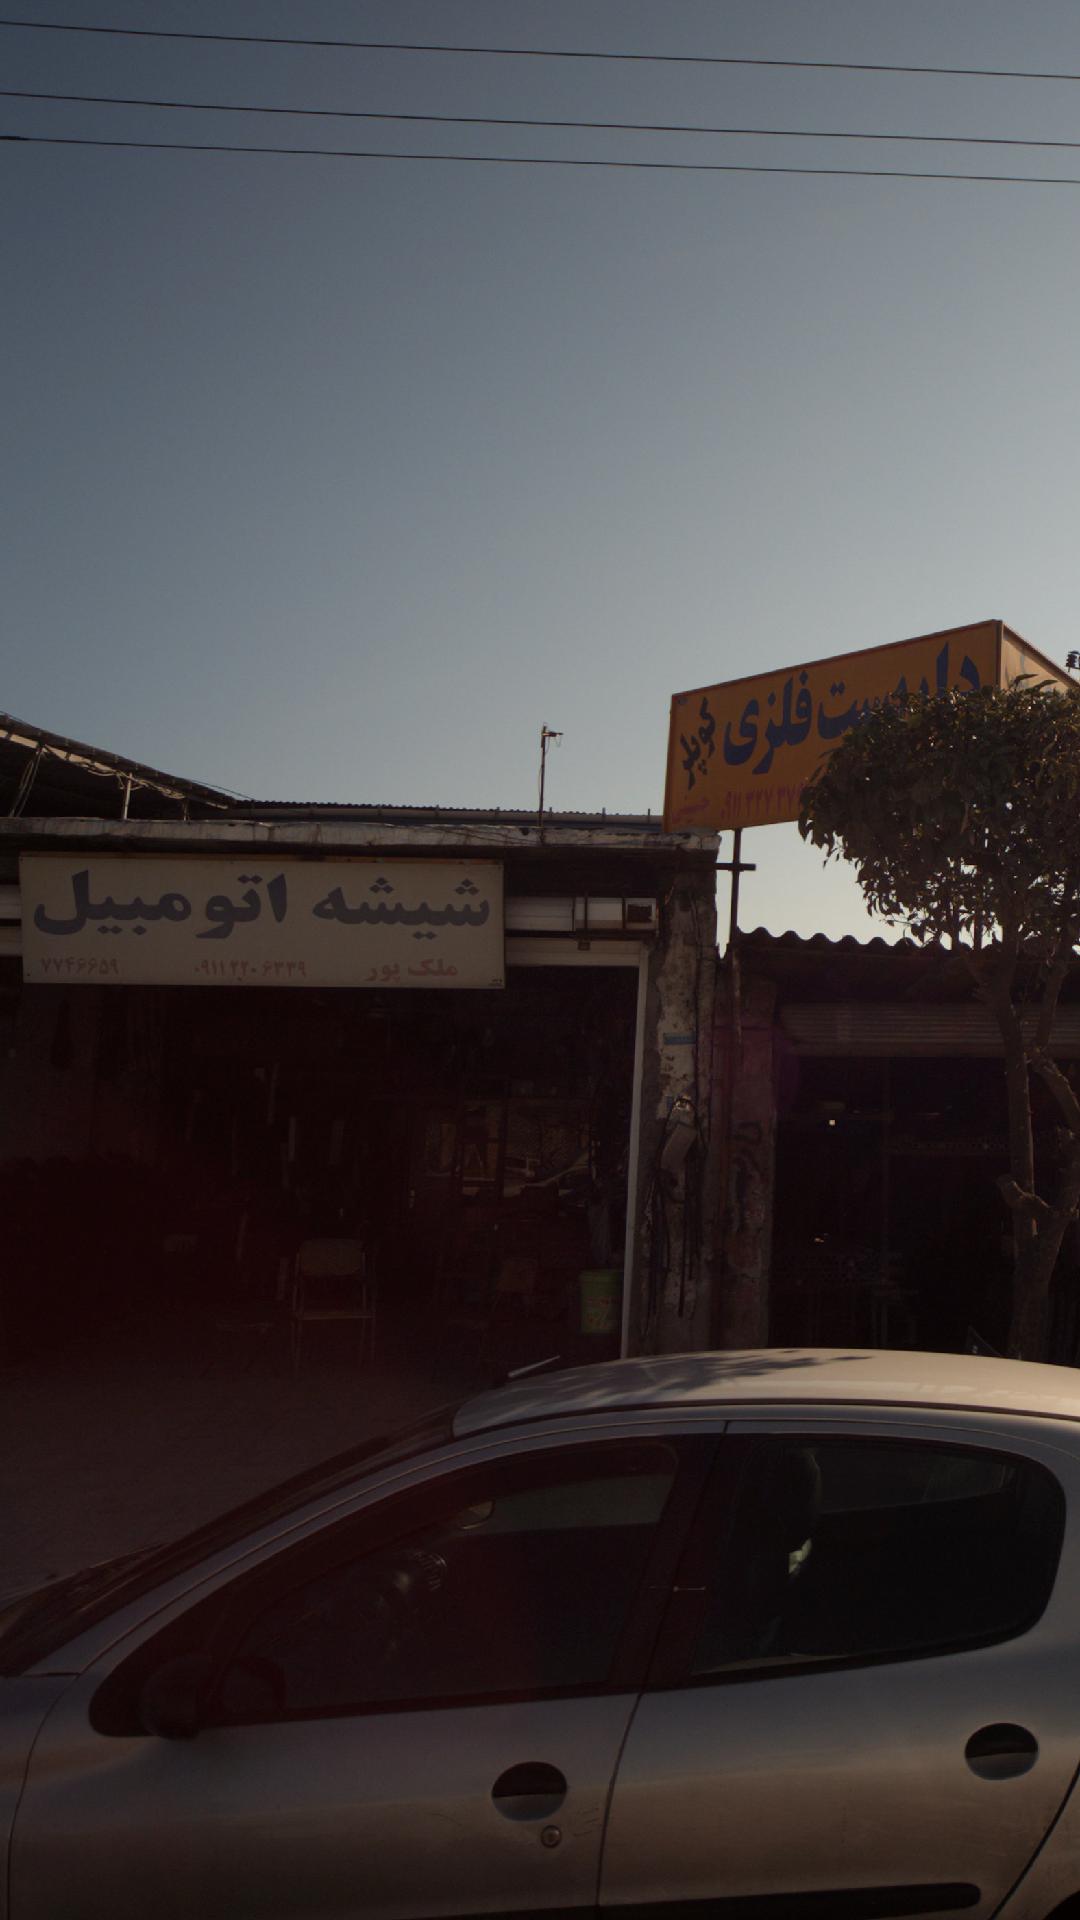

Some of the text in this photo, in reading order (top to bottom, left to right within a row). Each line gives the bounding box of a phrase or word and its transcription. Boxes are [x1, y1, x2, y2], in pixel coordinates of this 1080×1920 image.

[723, 671, 812, 775] فلزی
[312, 877, 490, 941] شیشه
[363, 957, 459, 983] ملک پور
